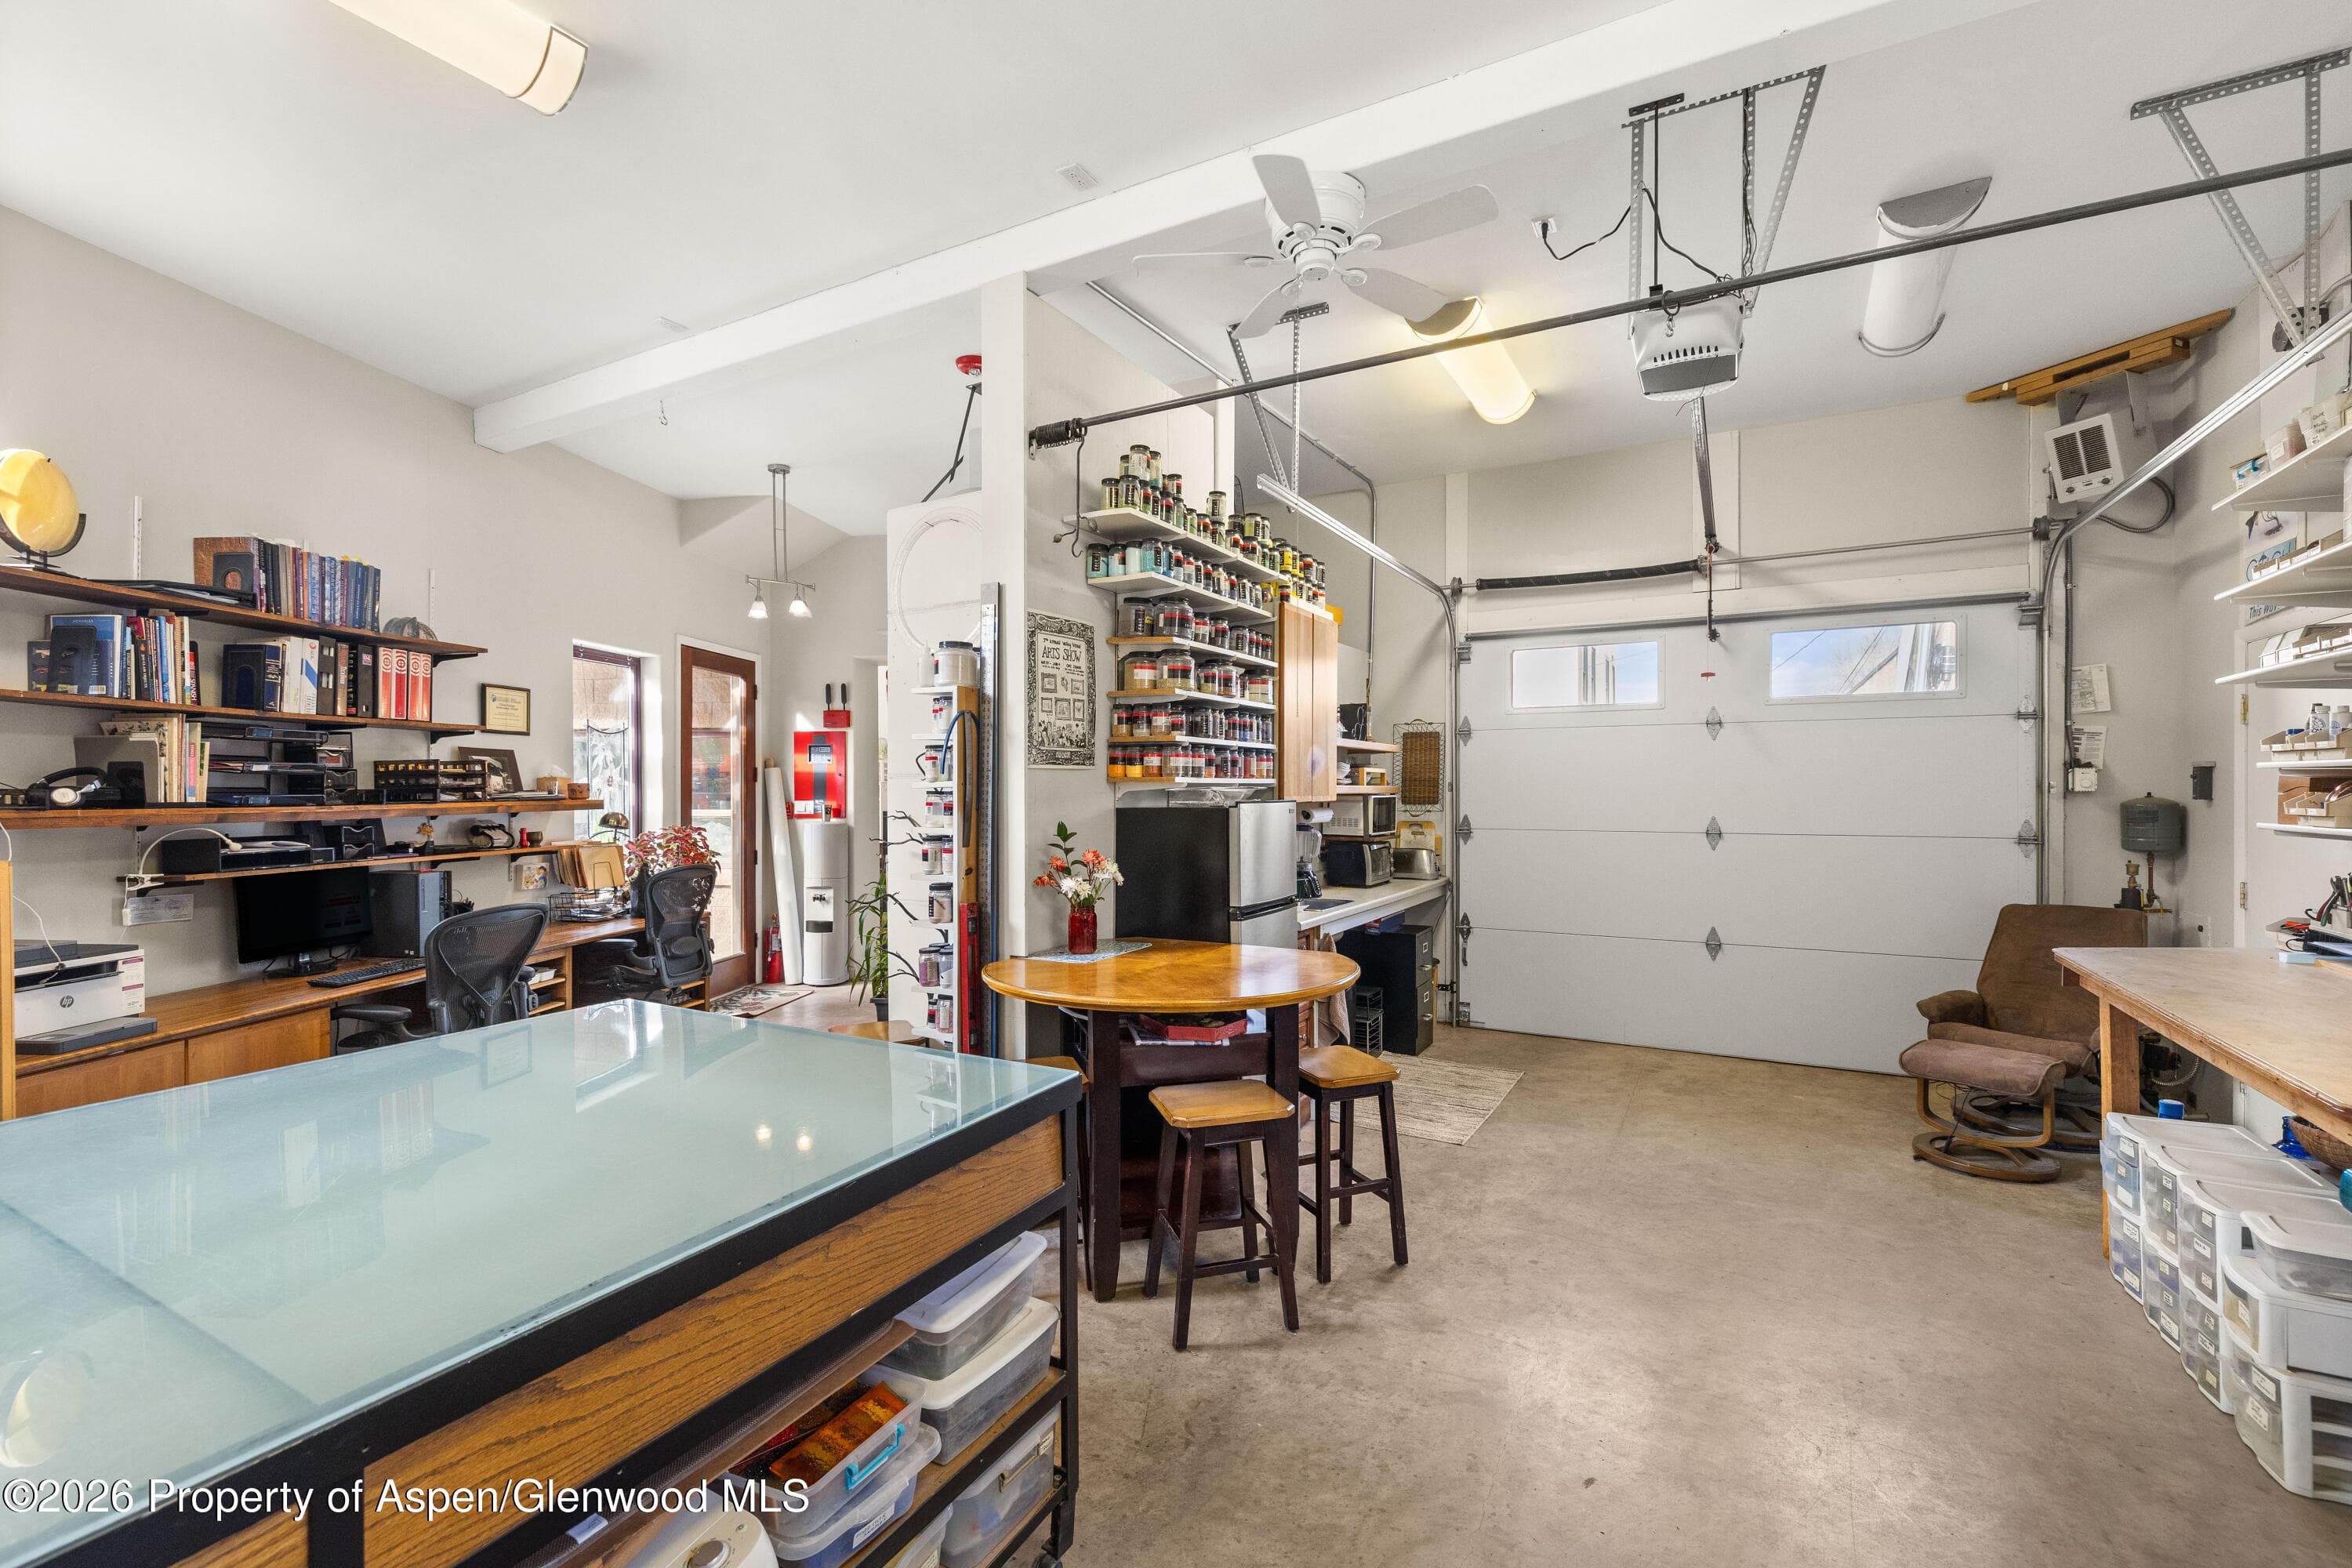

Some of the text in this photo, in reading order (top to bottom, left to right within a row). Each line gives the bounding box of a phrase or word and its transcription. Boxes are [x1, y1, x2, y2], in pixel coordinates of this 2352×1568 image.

[1042, 645, 1082, 662] ARTS SHOW
[61, 996, 74, 1008] hp
